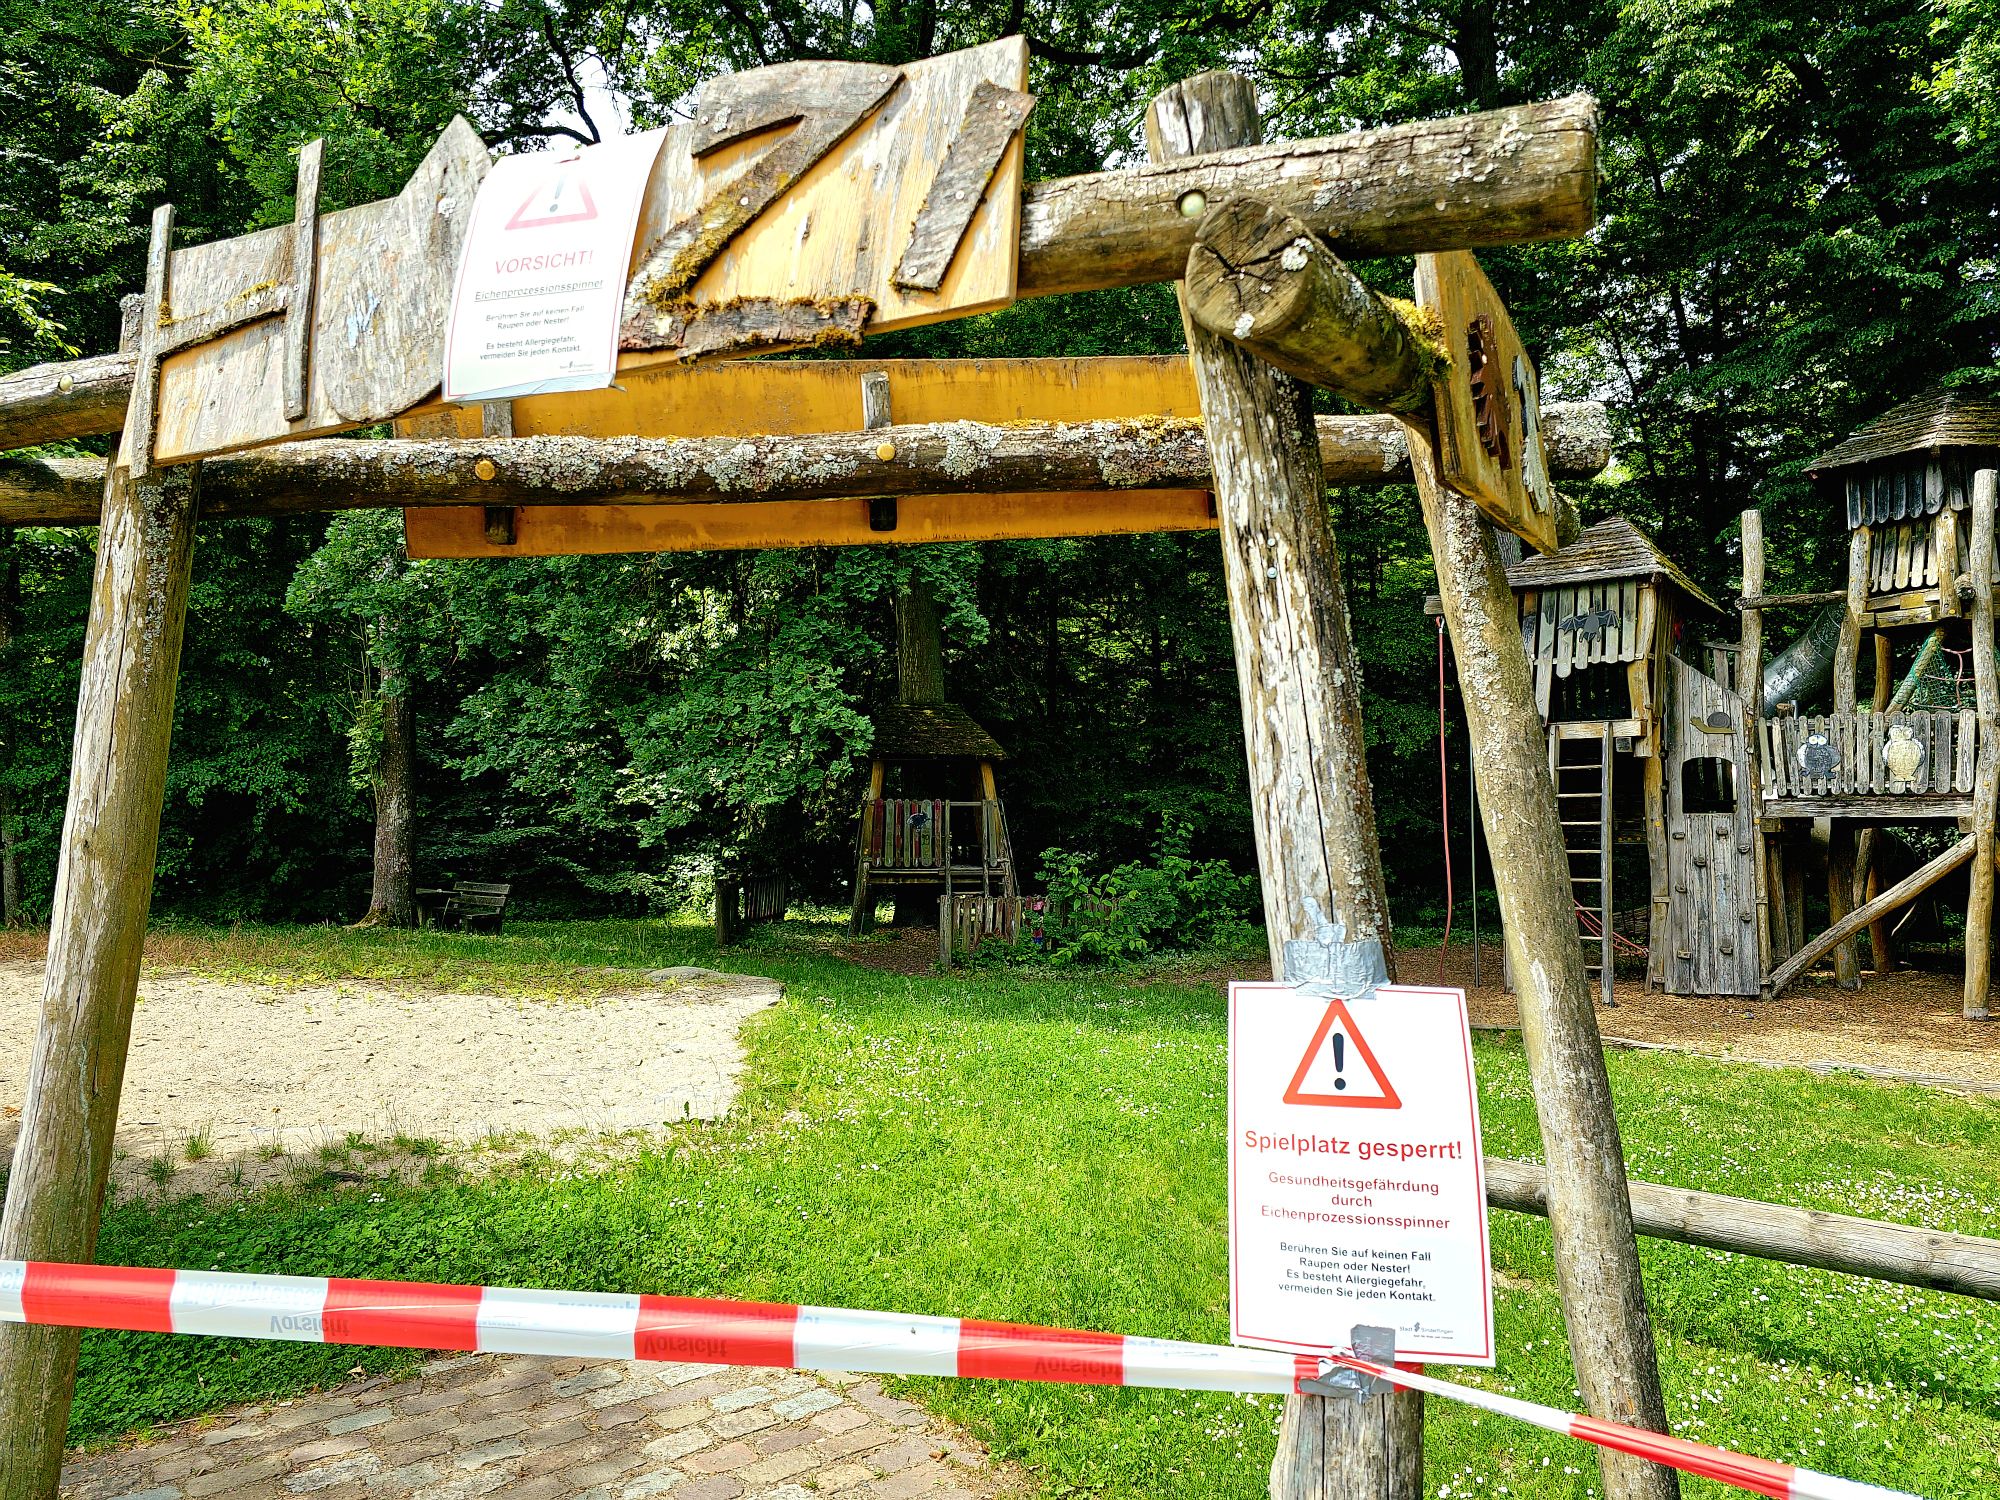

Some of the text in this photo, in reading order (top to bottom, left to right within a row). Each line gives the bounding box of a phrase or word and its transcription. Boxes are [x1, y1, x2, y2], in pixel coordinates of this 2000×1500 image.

[495, 250, 593, 274] VORSICHT!
[475, 280, 604, 301] Eichenprozessionsspinner
[520, 311, 530, 319] Sie
[532, 309, 544, 317] auf
[497, 322, 524, 330] Raupen
[480, 344, 581, 360] vermeiden Sie jeden Kontakt.
[497, 341, 523, 349] besteht
[1245, 1130, 1462, 1162] Spielplatz gesperrt!
[1268, 1171, 1440, 1196] Gesundheitsgefährdung
[1331, 1194, 1373, 1208] durch
[1261, 1205, 1450, 1229] Eichenprozessionsspinner
[1280, 1241, 1432, 1261] Berühren Sie auf keinen Fall
[1299, 1257, 1411, 1274] Raupen oder Nester!
[1286, 1269, 1426, 1289] Es besteht Allergiegefahr,
[1278, 1283, 1437, 1302] vermeiden Sie jeden Kontakt.
